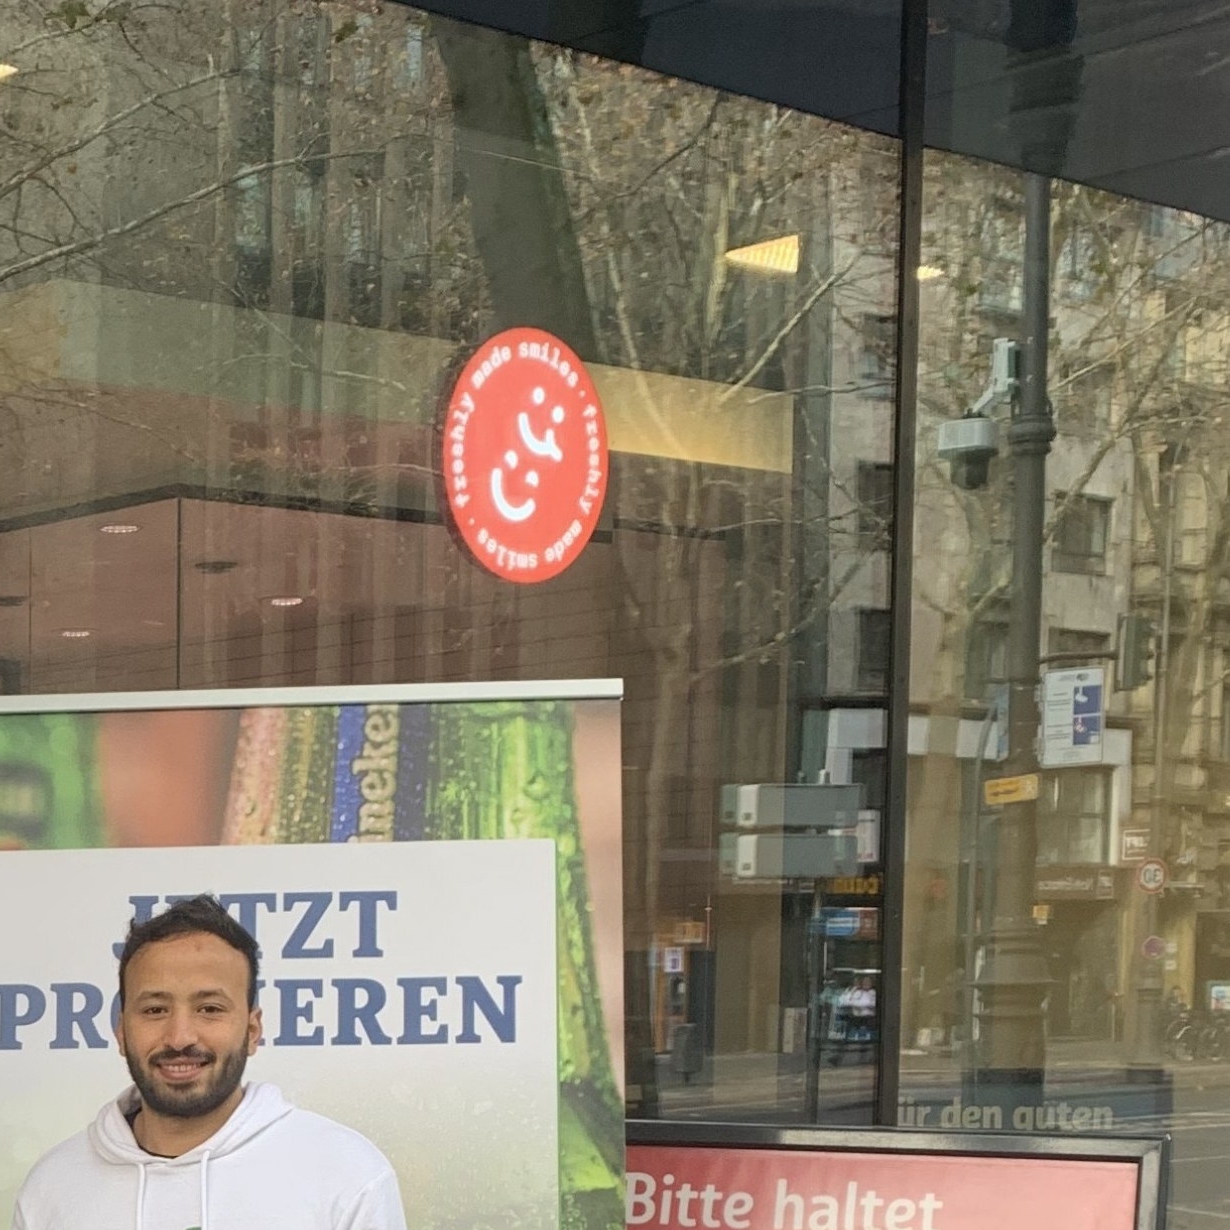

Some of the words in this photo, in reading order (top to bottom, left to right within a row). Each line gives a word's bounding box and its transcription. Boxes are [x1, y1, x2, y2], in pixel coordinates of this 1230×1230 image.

[471, 345, 512, 390] made
[519, 341, 580, 389] smiles
[477, 528, 538, 572] smiles
[545, 519, 583, 563] made
[941, 1096, 1004, 1130] den
[625, 1172, 755, 1230] Bitte
